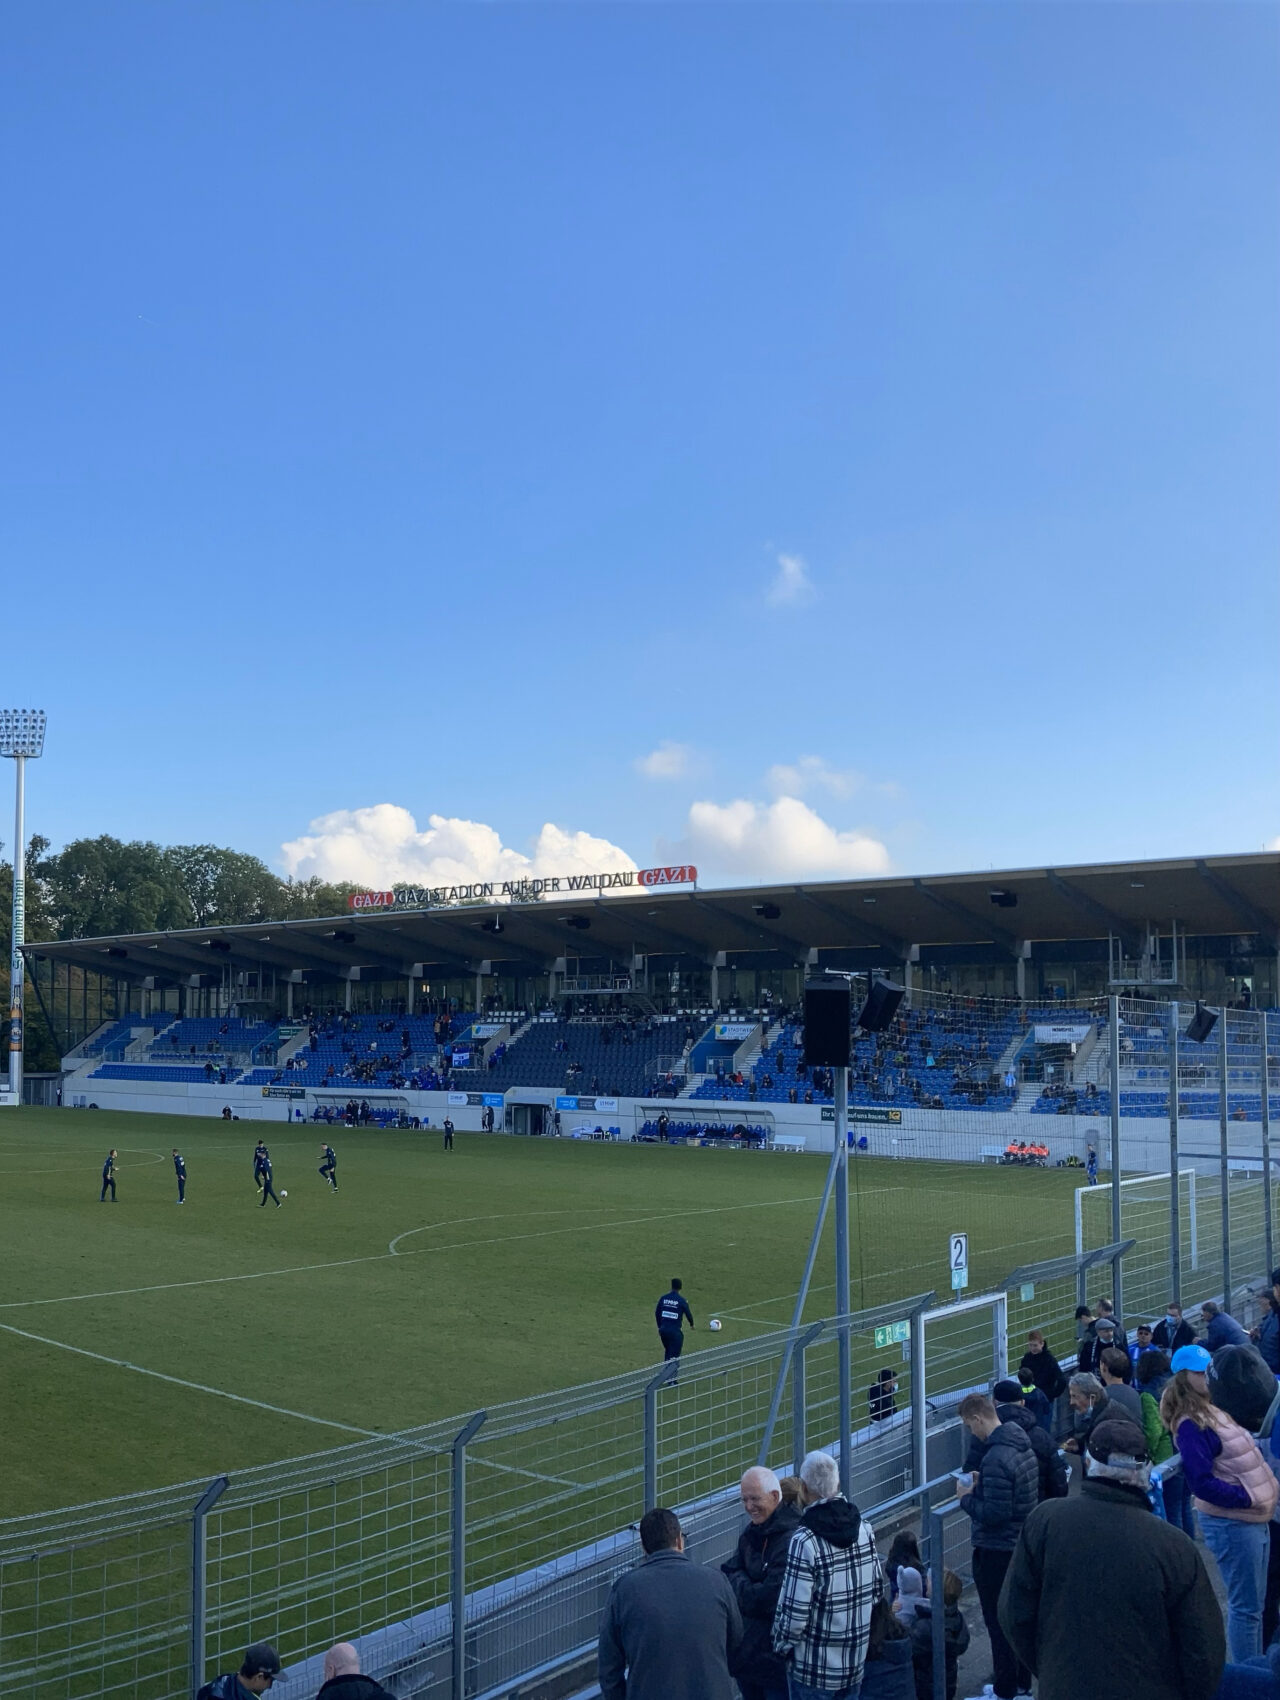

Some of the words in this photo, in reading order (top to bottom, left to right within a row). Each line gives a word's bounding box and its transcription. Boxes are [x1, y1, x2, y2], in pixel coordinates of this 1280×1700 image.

[433, 882, 493, 900] STADION
[501, 880, 527, 896] AUF
[532, 877, 560, 893] DER
[567, 871, 633, 890] WALDAU
[643, 867, 691, 886] GAZI
[354, 893, 389, 908] GAZI
[954, 1239, 963, 1268] 2
